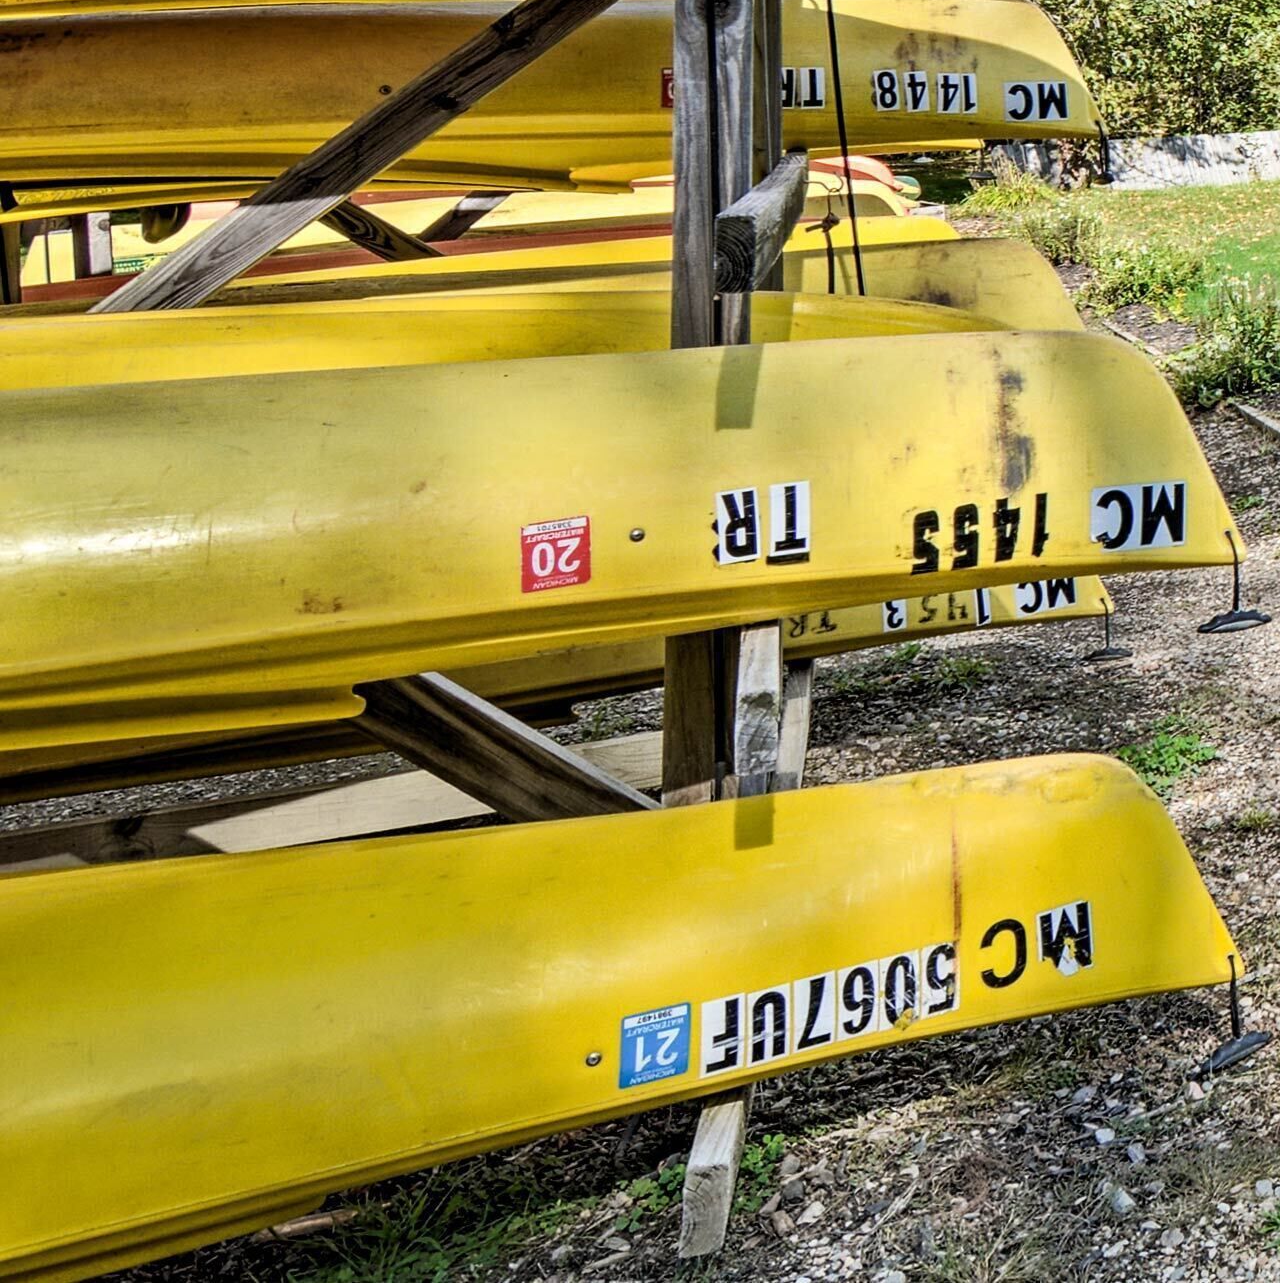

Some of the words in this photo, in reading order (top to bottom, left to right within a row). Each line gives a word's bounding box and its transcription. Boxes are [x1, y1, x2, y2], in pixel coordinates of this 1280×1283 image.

[879, 71, 976, 112] 1448
[1008, 83, 1067, 120] MC
[525, 528, 584, 543] WATERCRAFT
[720, 485, 808, 562] TR
[911, 493, 1048, 575] 1455
[1096, 484, 1185, 550] MC
[531, 537, 581, 577] 20
[533, 576, 578, 589] MICHIGAN
[1020, 577, 1076, 613] MC
[886, 588, 989, 628] 1453
[980, 902, 1092, 988] MC
[626, 1017, 684, 1037] WATERCRAFT
[706, 943, 956, 1073] 5067UF
[634, 1028, 680, 1072] 21
[629, 1069, 675, 1084] MICHIGAN
